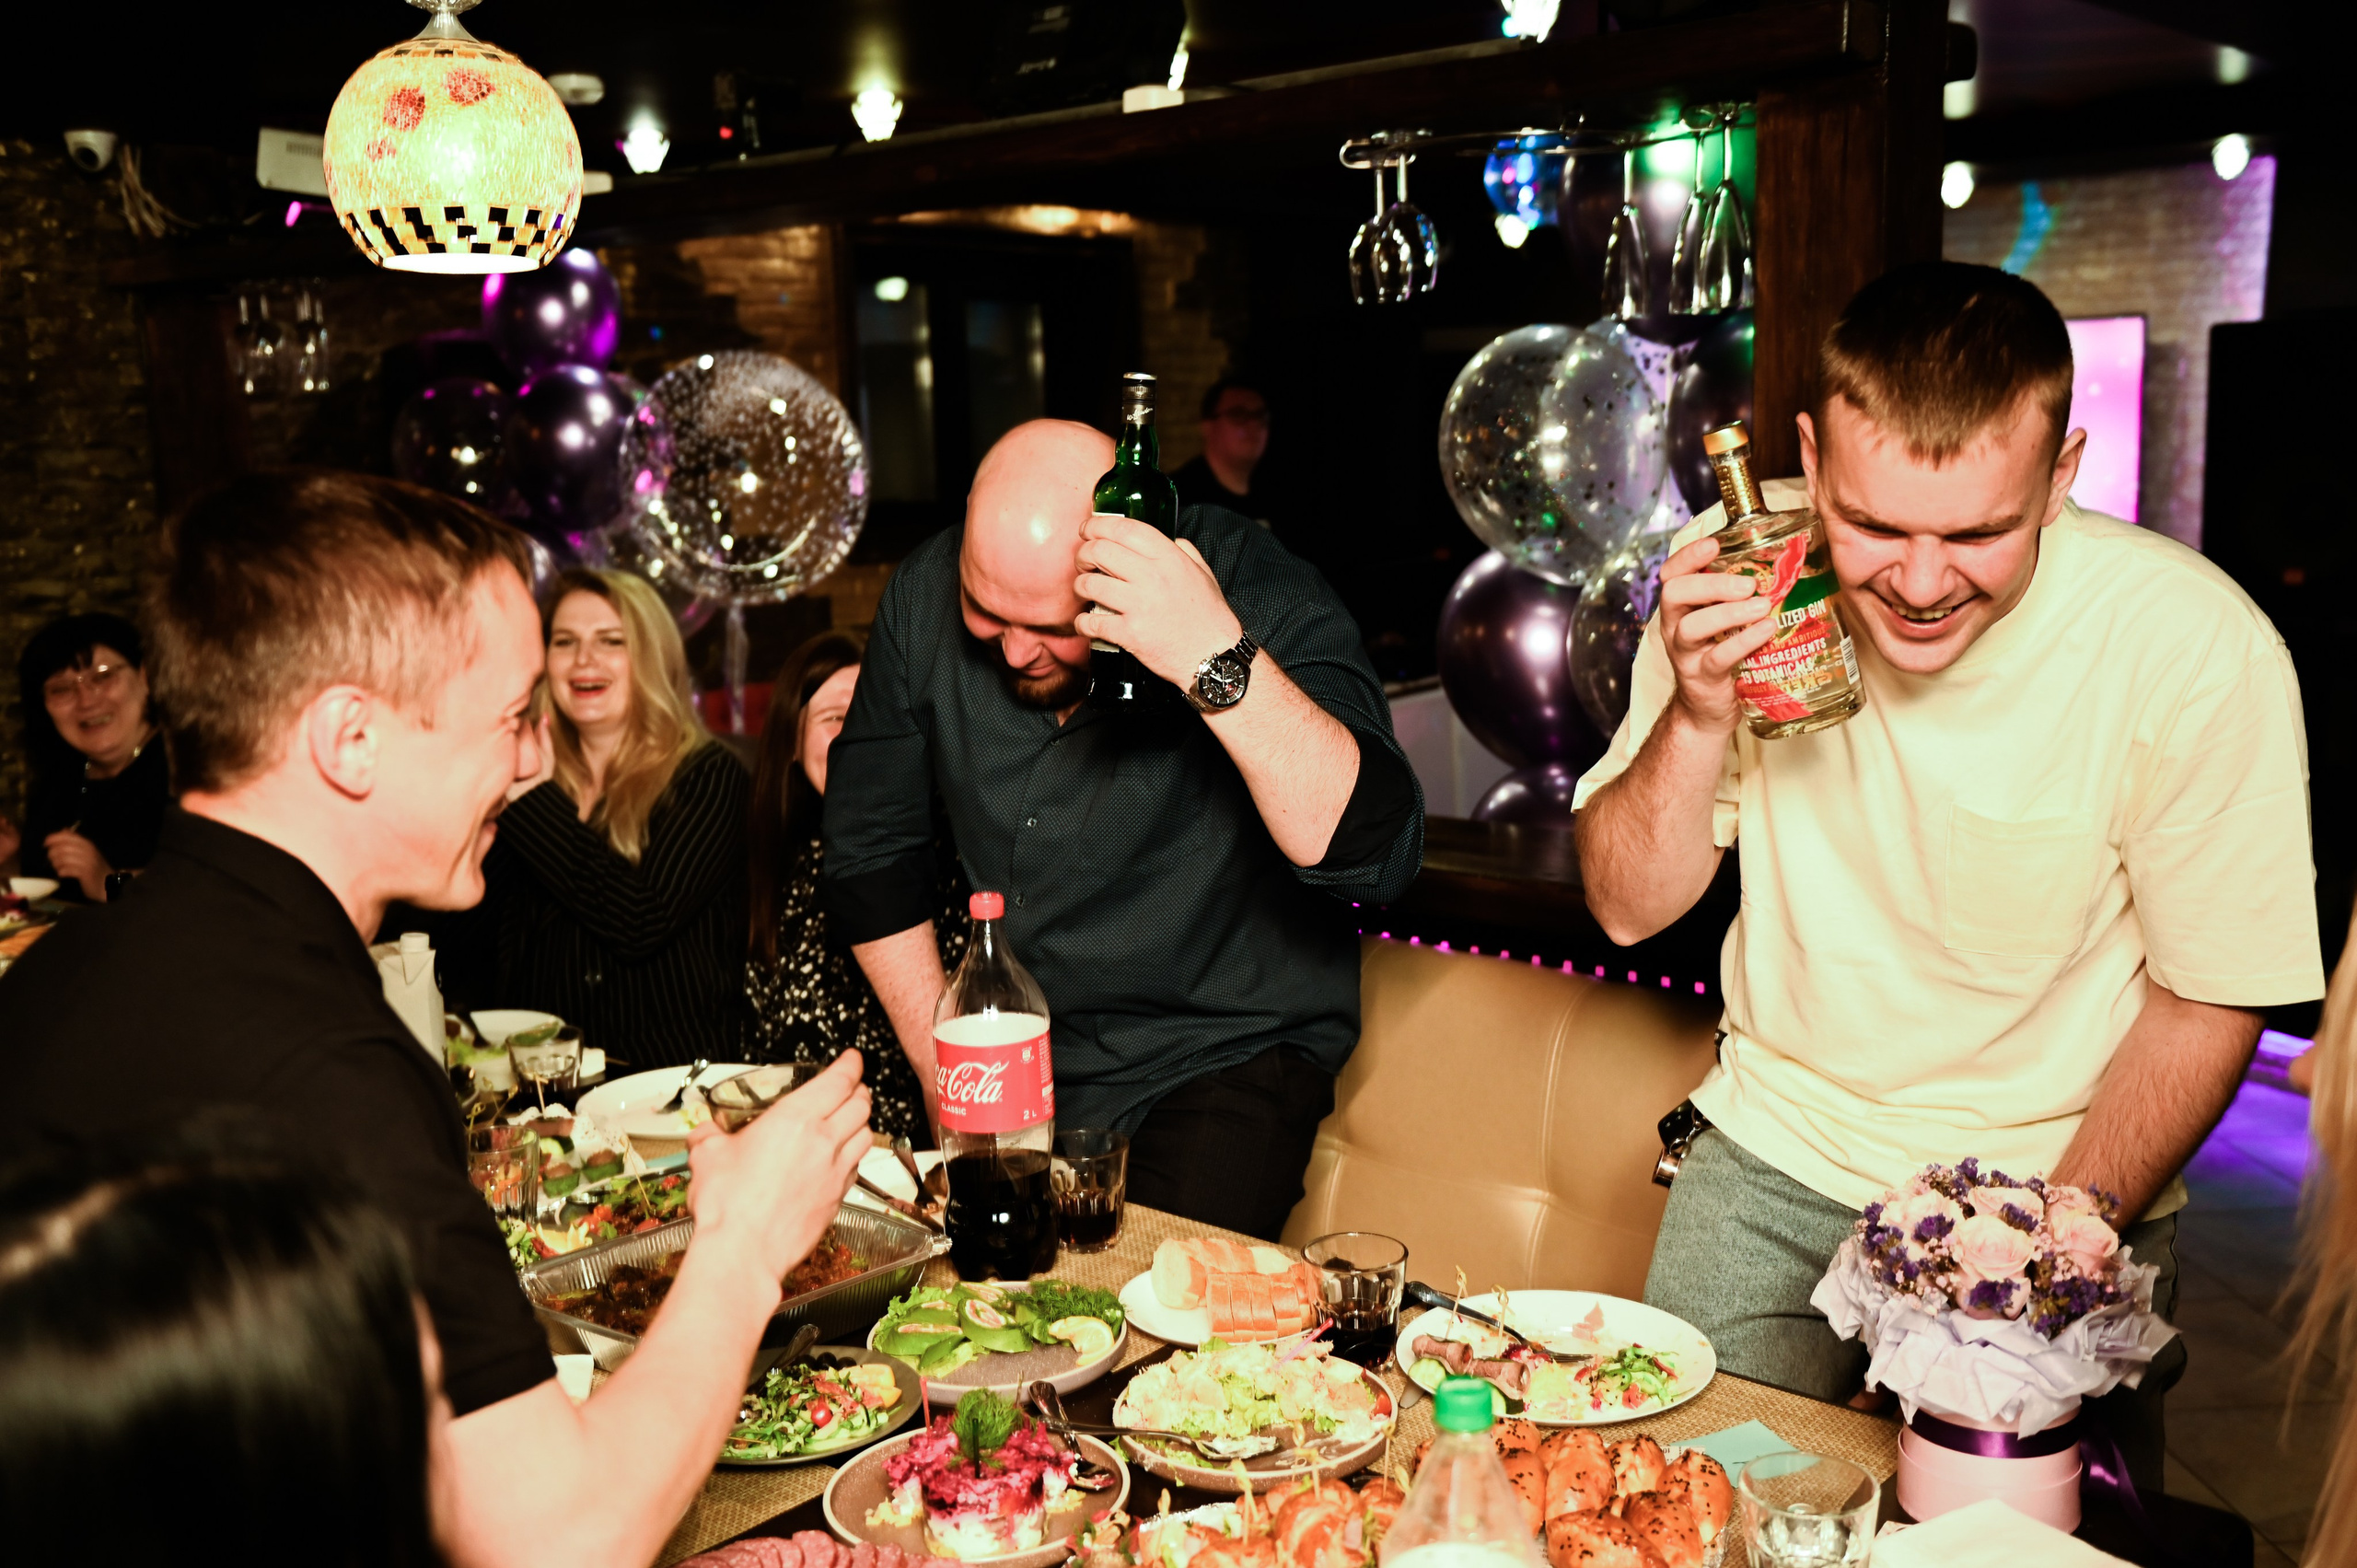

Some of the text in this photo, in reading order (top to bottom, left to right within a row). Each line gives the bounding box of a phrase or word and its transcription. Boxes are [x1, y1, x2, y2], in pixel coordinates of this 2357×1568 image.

[1776, 598, 1827, 629] LIZED GIN
[1759, 637, 1827, 667] INGREDIENTS
[1752, 657, 1814, 683] BOTANICALS
[941, 1102, 967, 1116] CLASSIC
[1023, 1109, 1038, 1121] 2 L
